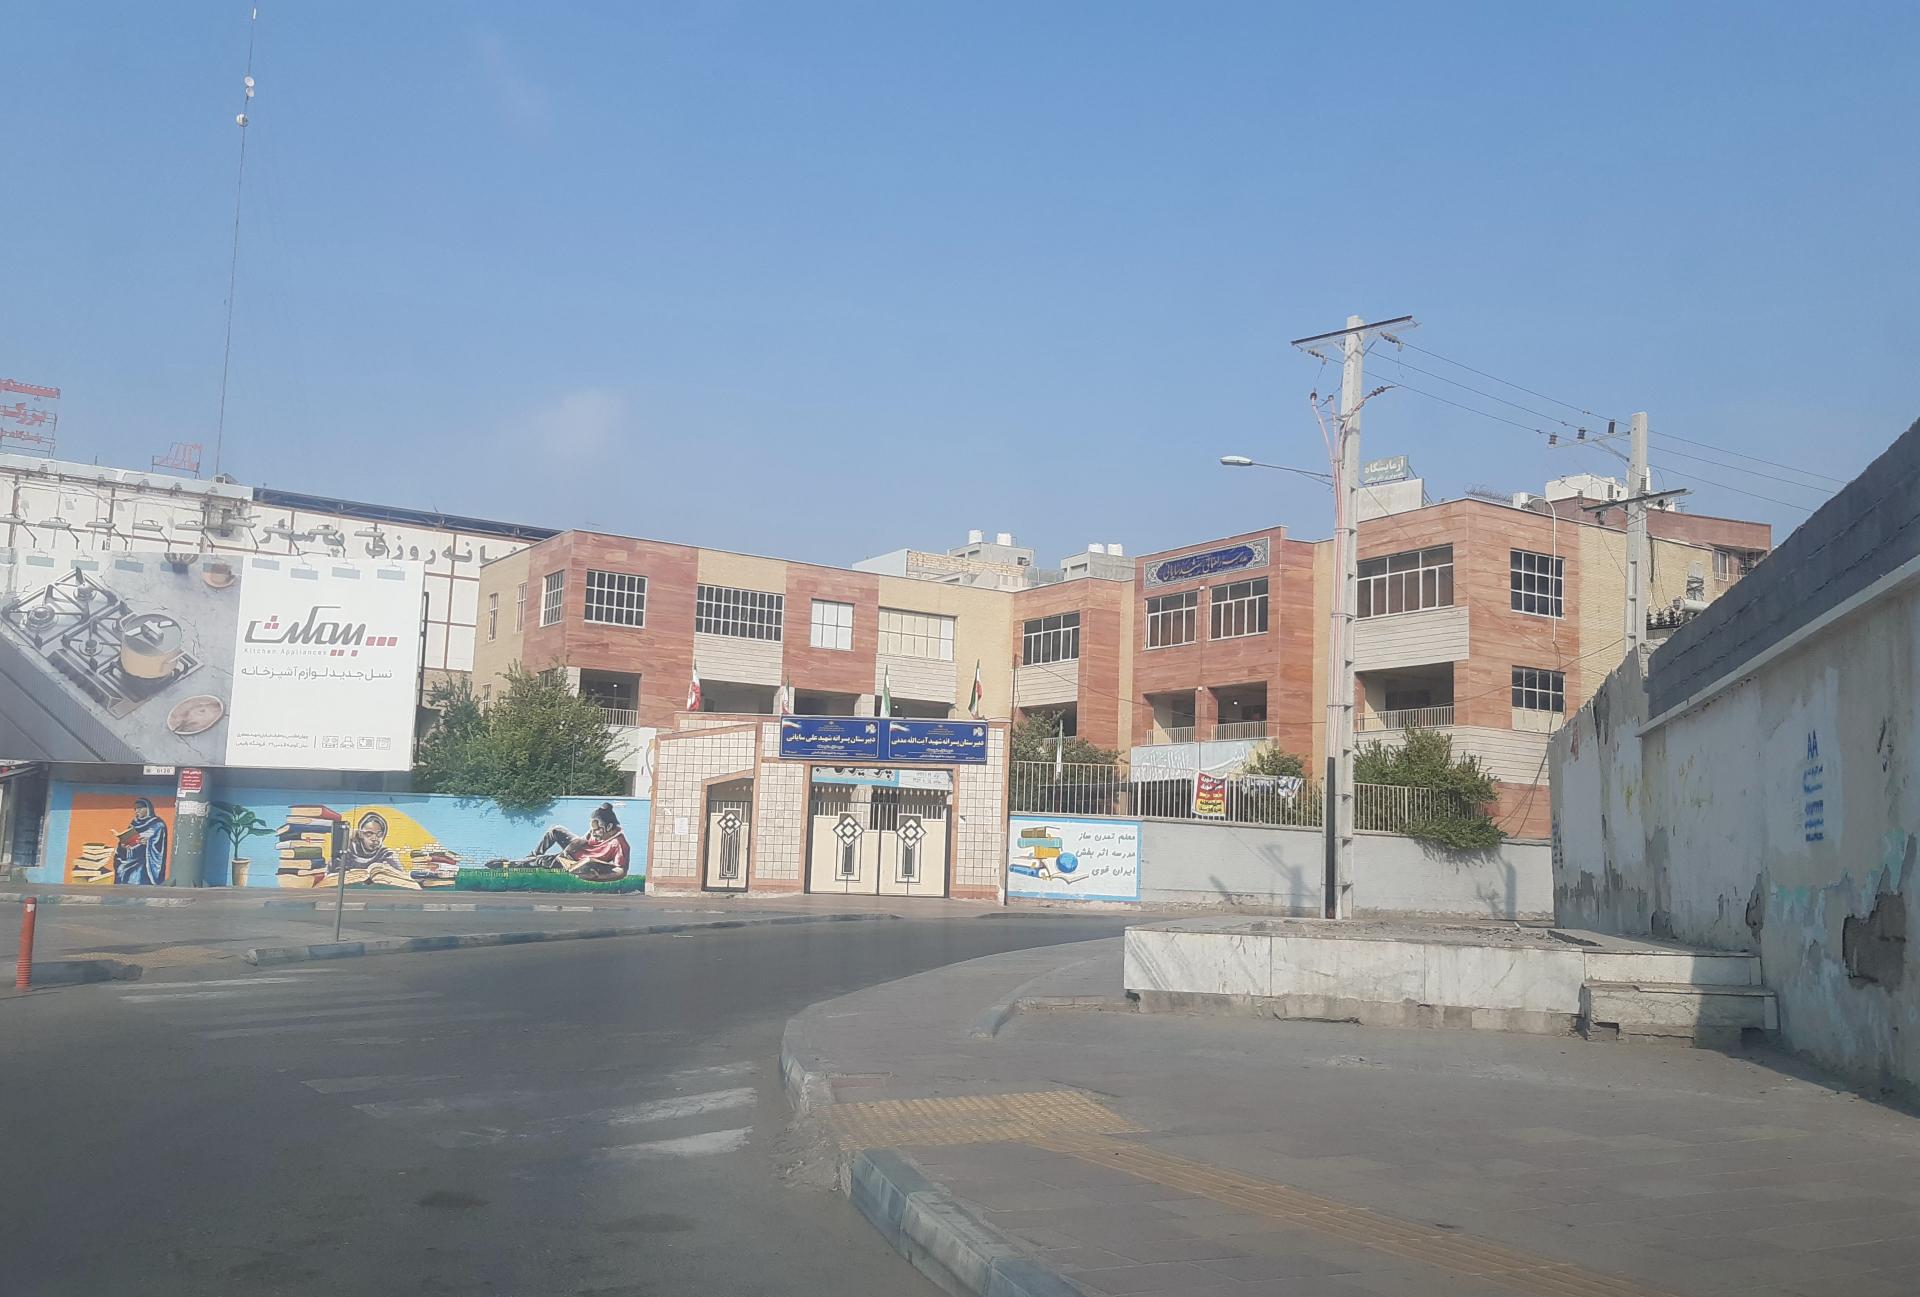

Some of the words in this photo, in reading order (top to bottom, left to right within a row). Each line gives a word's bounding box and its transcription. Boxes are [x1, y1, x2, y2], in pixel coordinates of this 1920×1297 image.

[241, 665, 297, 681] آشپزخانه
[297, 666, 329, 681] لوازم
[328, 668, 364, 681] جدید
[364, 667, 393, 682] نسل
[817, 734, 832, 743] شهید
[833, 734, 851, 744] پسرانه
[851, 735, 876, 745] دبیرستان
[928, 738, 942, 746] شهید
[942, 738, 960, 747] پسرانه
[960, 738, 985, 748] دبیرستان
[1078, 831, 1092, 842] ساز
[1094, 831, 1116, 842] تمدن
[1117, 833, 1136, 844] معلم
[1075, 847, 1095, 858] بخش
[1097, 847, 1109, 858] اثر
[1111, 850, 1136, 859] مدرسه
[1091, 866, 1110, 877] قوی
[1112, 867, 1136, 876] ایران
